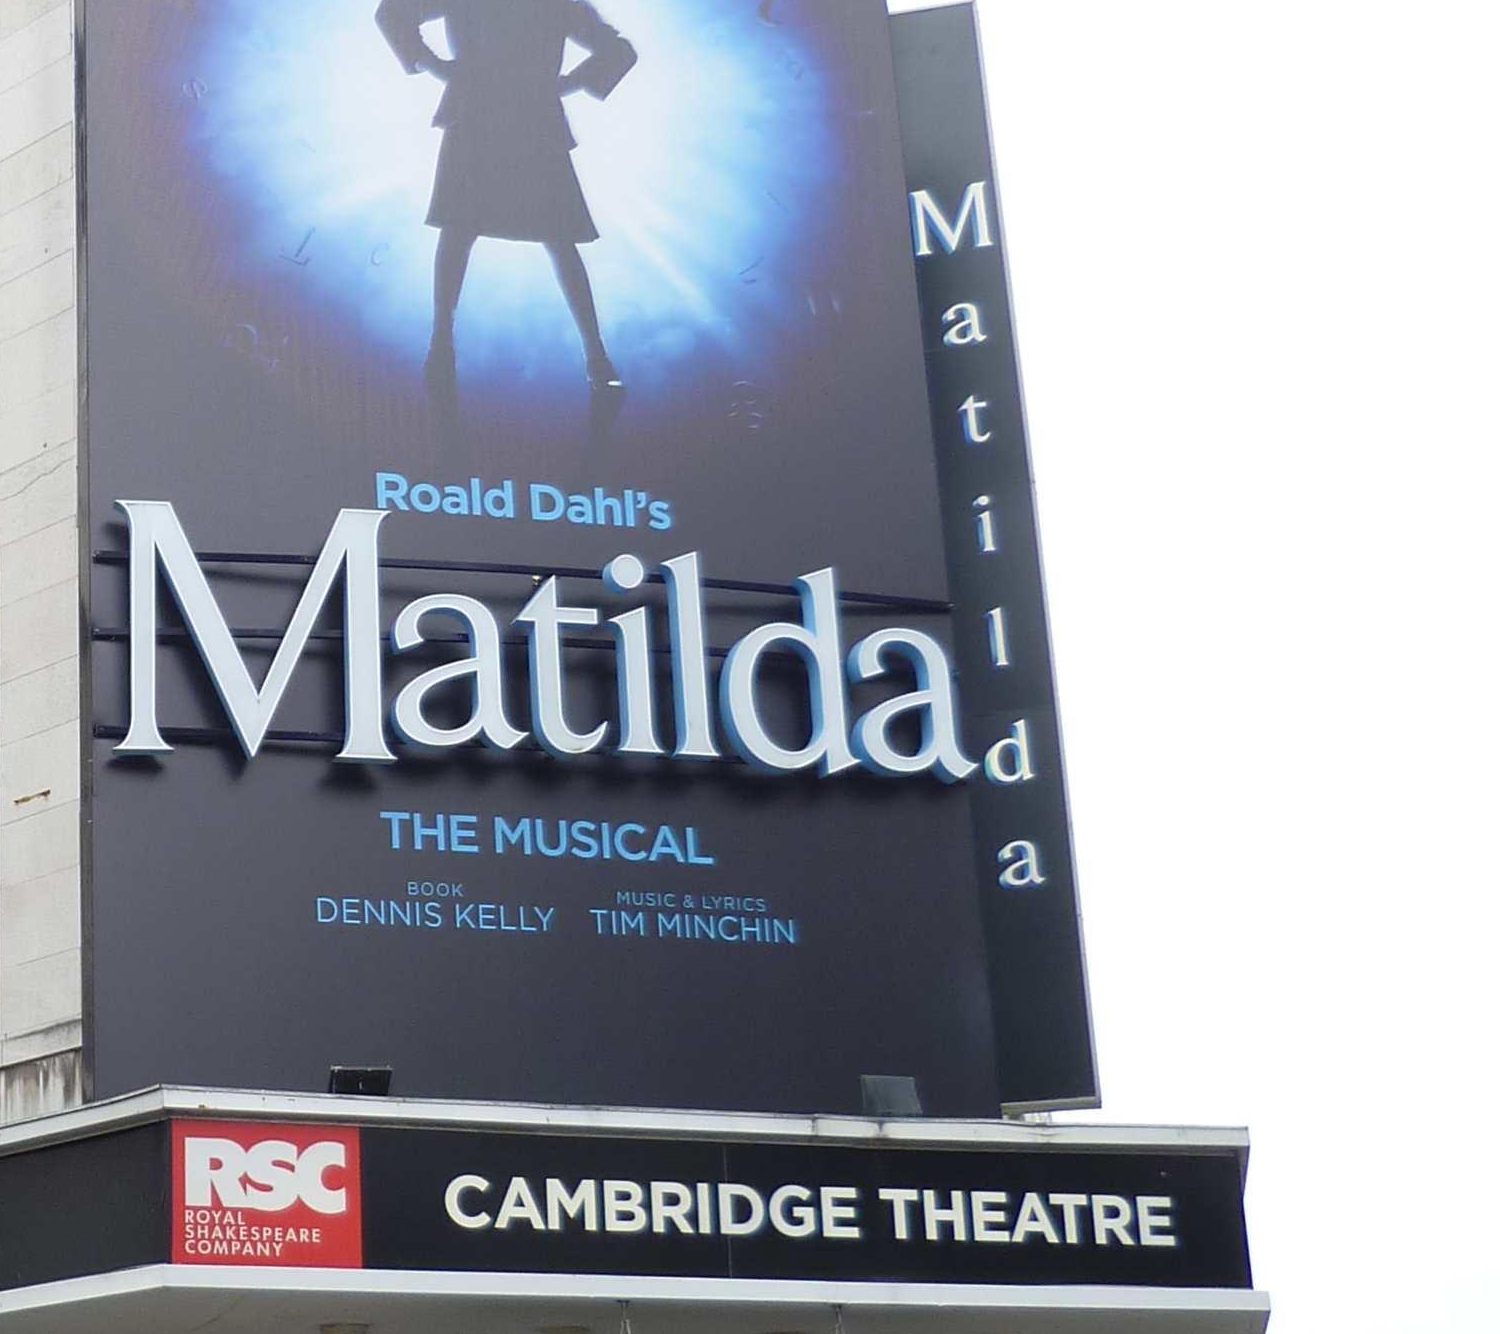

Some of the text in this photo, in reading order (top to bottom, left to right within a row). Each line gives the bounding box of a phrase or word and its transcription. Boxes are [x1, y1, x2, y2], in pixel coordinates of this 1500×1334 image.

[376, 472, 672, 530] Roald Dahl's
[908, 180, 1047, 887] Matilda
[112, 498, 981, 785] Matilda
[380, 811, 713, 866] THE MUSICAL
[407, 881, 464, 897] BOOK
[616, 891, 767, 912] MUSIC & LYRICS
[316, 897, 555, 932] DENNIS KELLY
[589, 909, 796, 944] TIM MINCHIN
[185, 1137, 346, 1214] RSC
[185, 1210, 245, 1225] ROYAL
[444, 1174, 1177, 1247] CAMBRIDGE THEATRE
[185, 1225, 321, 1243] SHAKESPEARE
[185, 1239, 283, 1257] COMPANY
